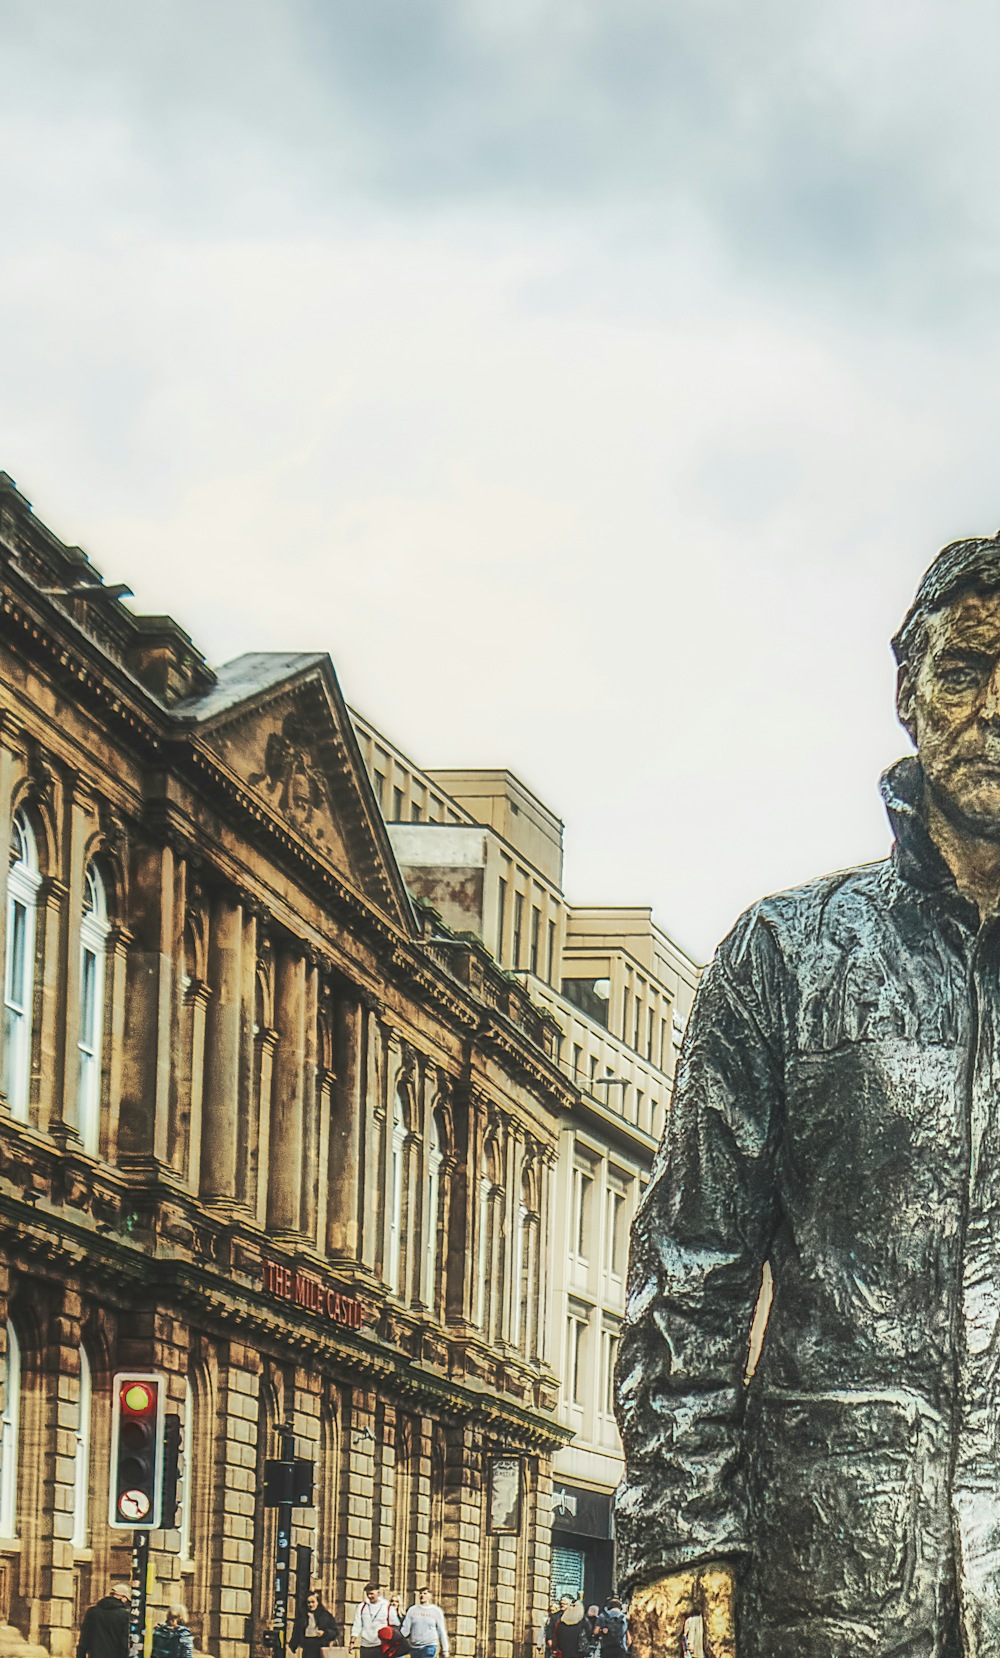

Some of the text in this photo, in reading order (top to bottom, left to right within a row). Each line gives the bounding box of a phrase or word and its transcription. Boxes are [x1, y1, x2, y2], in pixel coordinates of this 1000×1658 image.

[262, 1260, 365, 1331] THE MILE CASTLE
